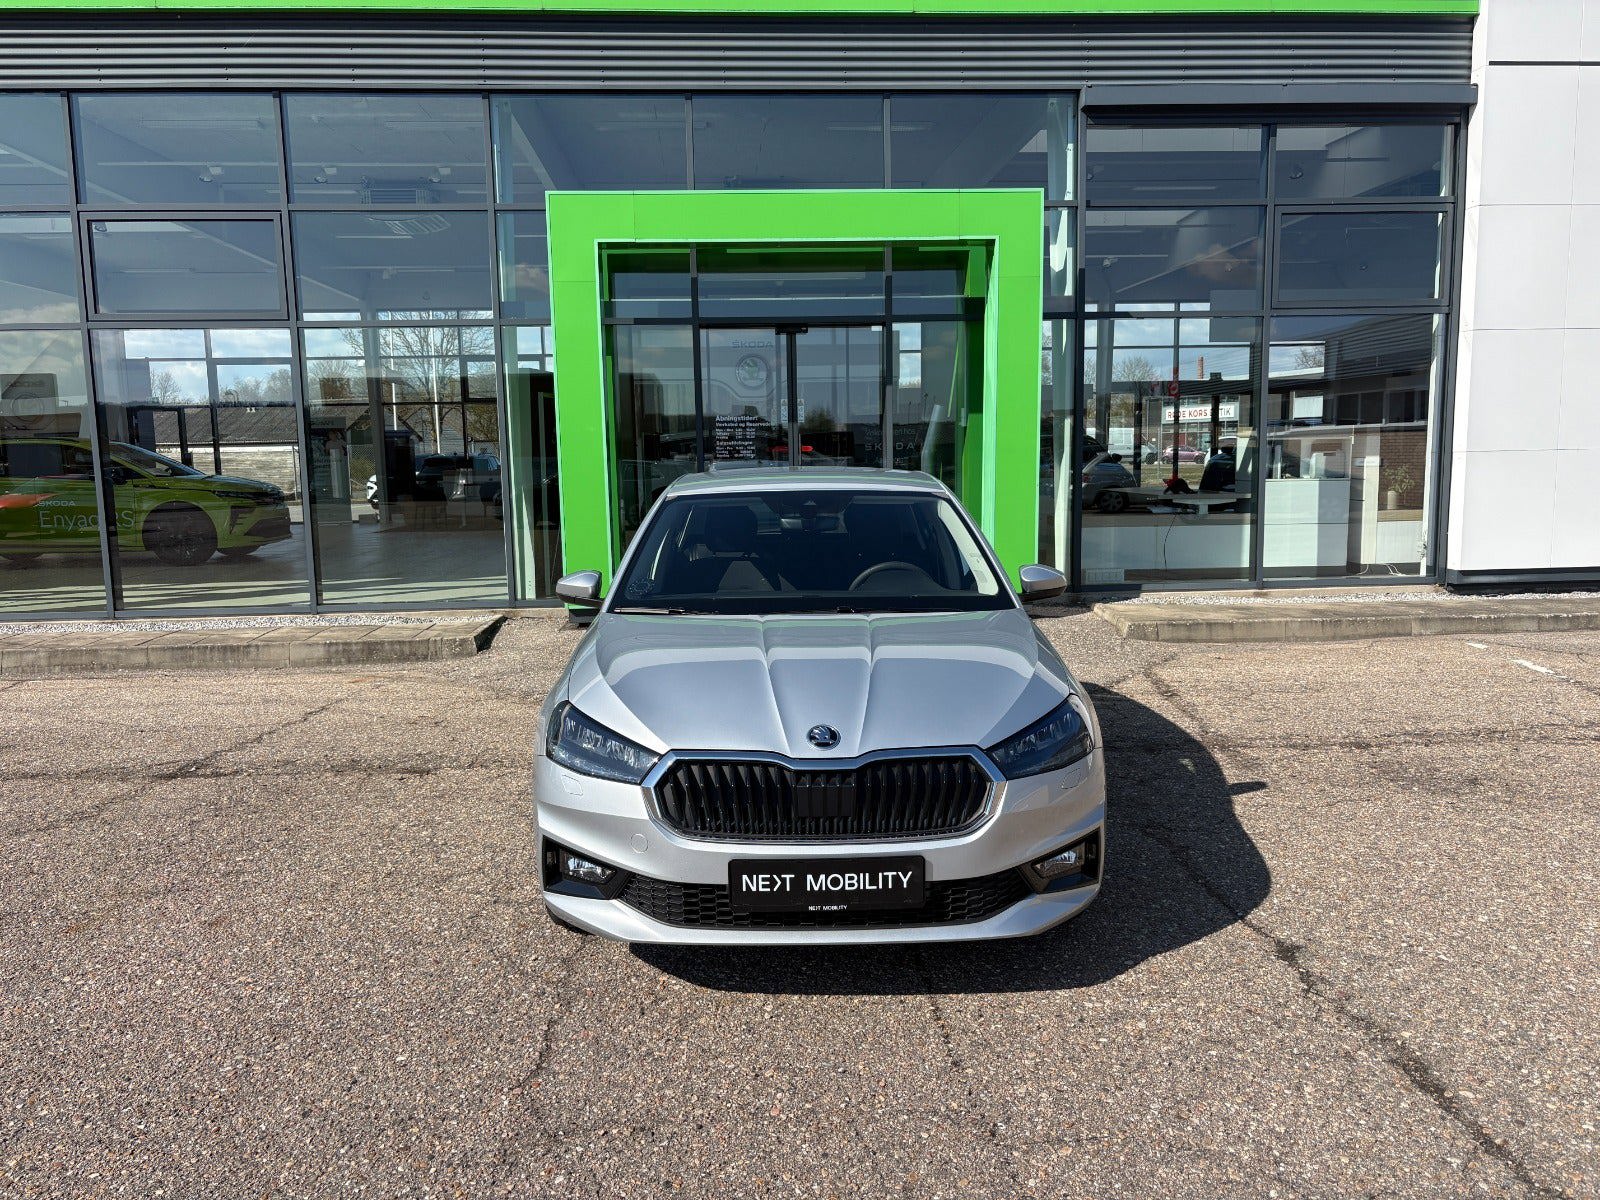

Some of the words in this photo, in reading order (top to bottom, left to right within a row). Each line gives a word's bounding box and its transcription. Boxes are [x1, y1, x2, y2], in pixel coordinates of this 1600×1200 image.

[1168, 410, 1186, 419] RDE
[1188, 409, 1208, 418] KORS
[864, 442, 915, 451] SKDA
[806, 871, 913, 892] MOBILITY
